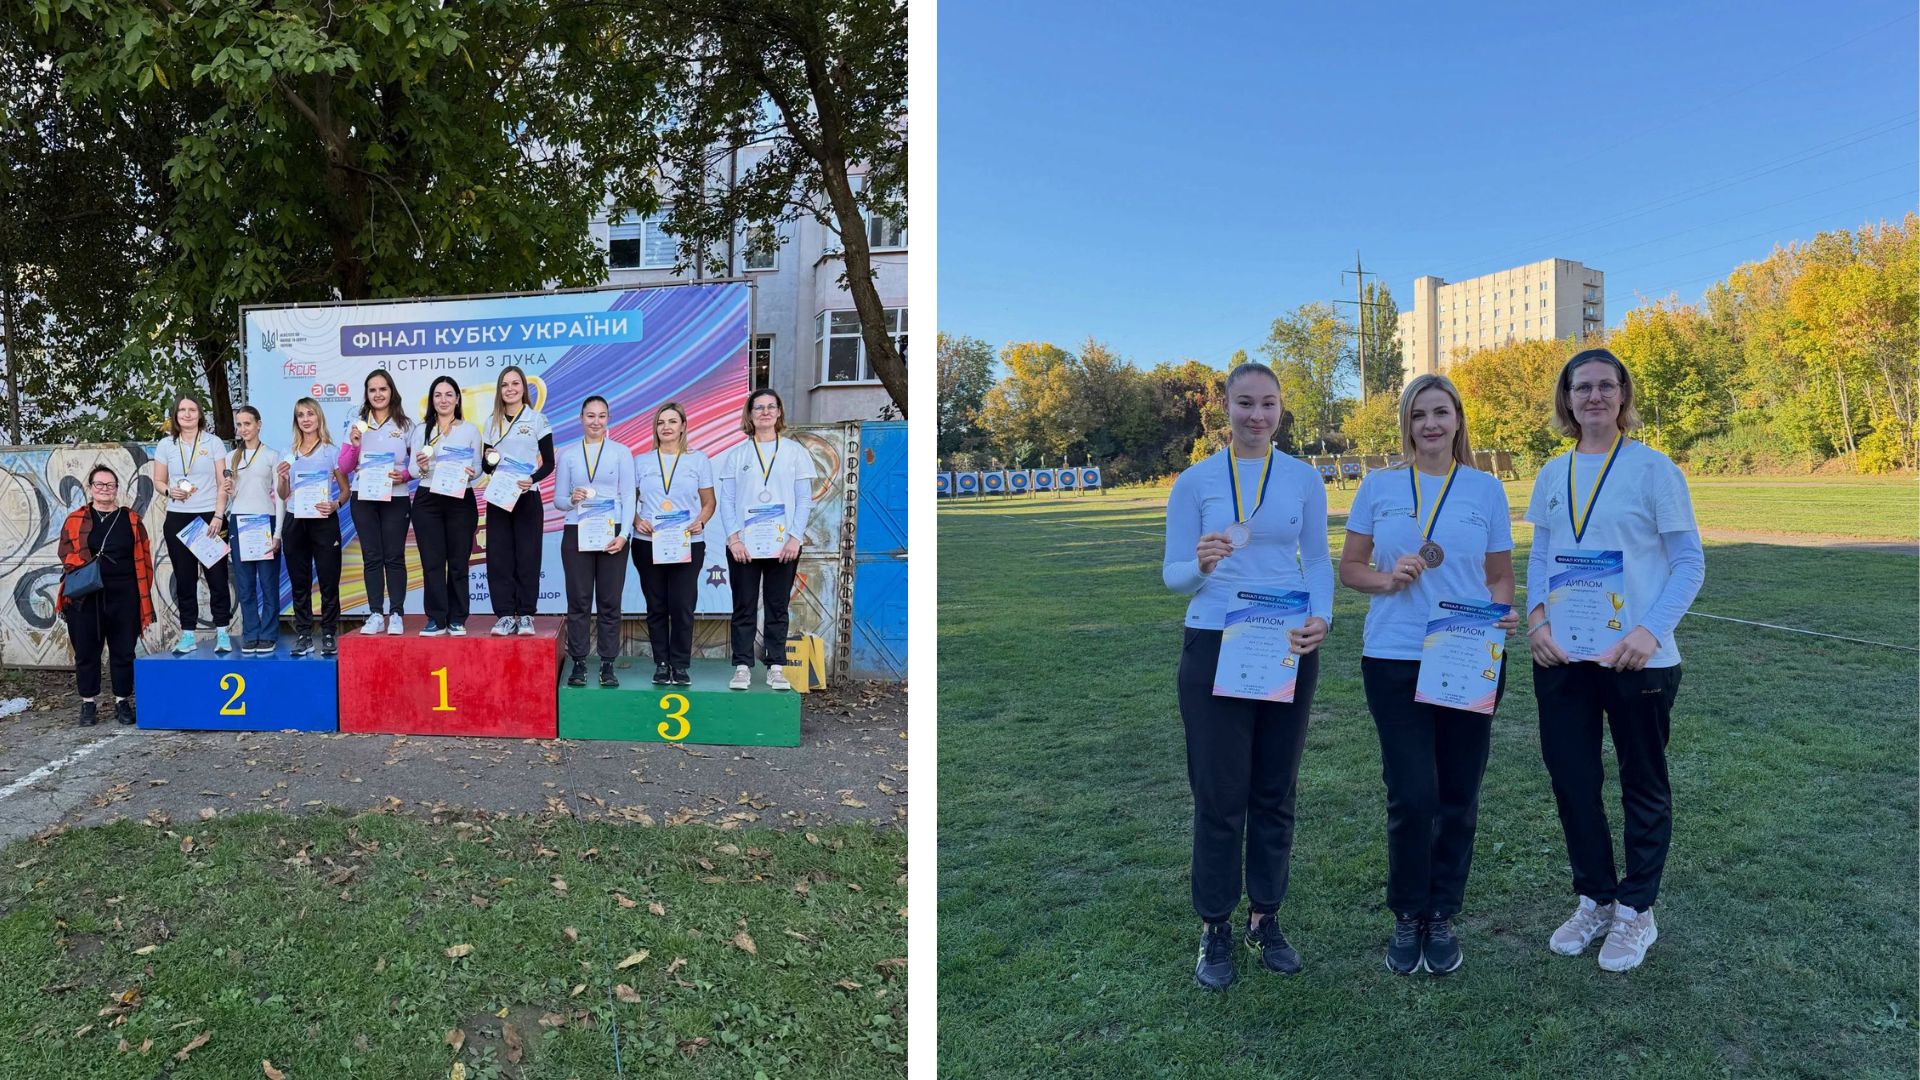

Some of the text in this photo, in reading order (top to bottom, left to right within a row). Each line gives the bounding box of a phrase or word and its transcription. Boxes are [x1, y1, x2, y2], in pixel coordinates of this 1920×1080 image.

[352, 314, 628, 349] ФІНАЛ КУБКУ УКРАЇНИ
[377, 353, 547, 371] ЗІ СТРІЛЬБИ З ЛУКА
[1566, 579, 1602, 588] ДИПЛОМ
[1244, 615, 1284, 626] ДИПЛОМ
[1446, 624, 1486, 637] ДИПЛОМ
[219, 673, 246, 715] 2
[431, 667, 457, 711] 1
[658, 693, 691, 741] 3
